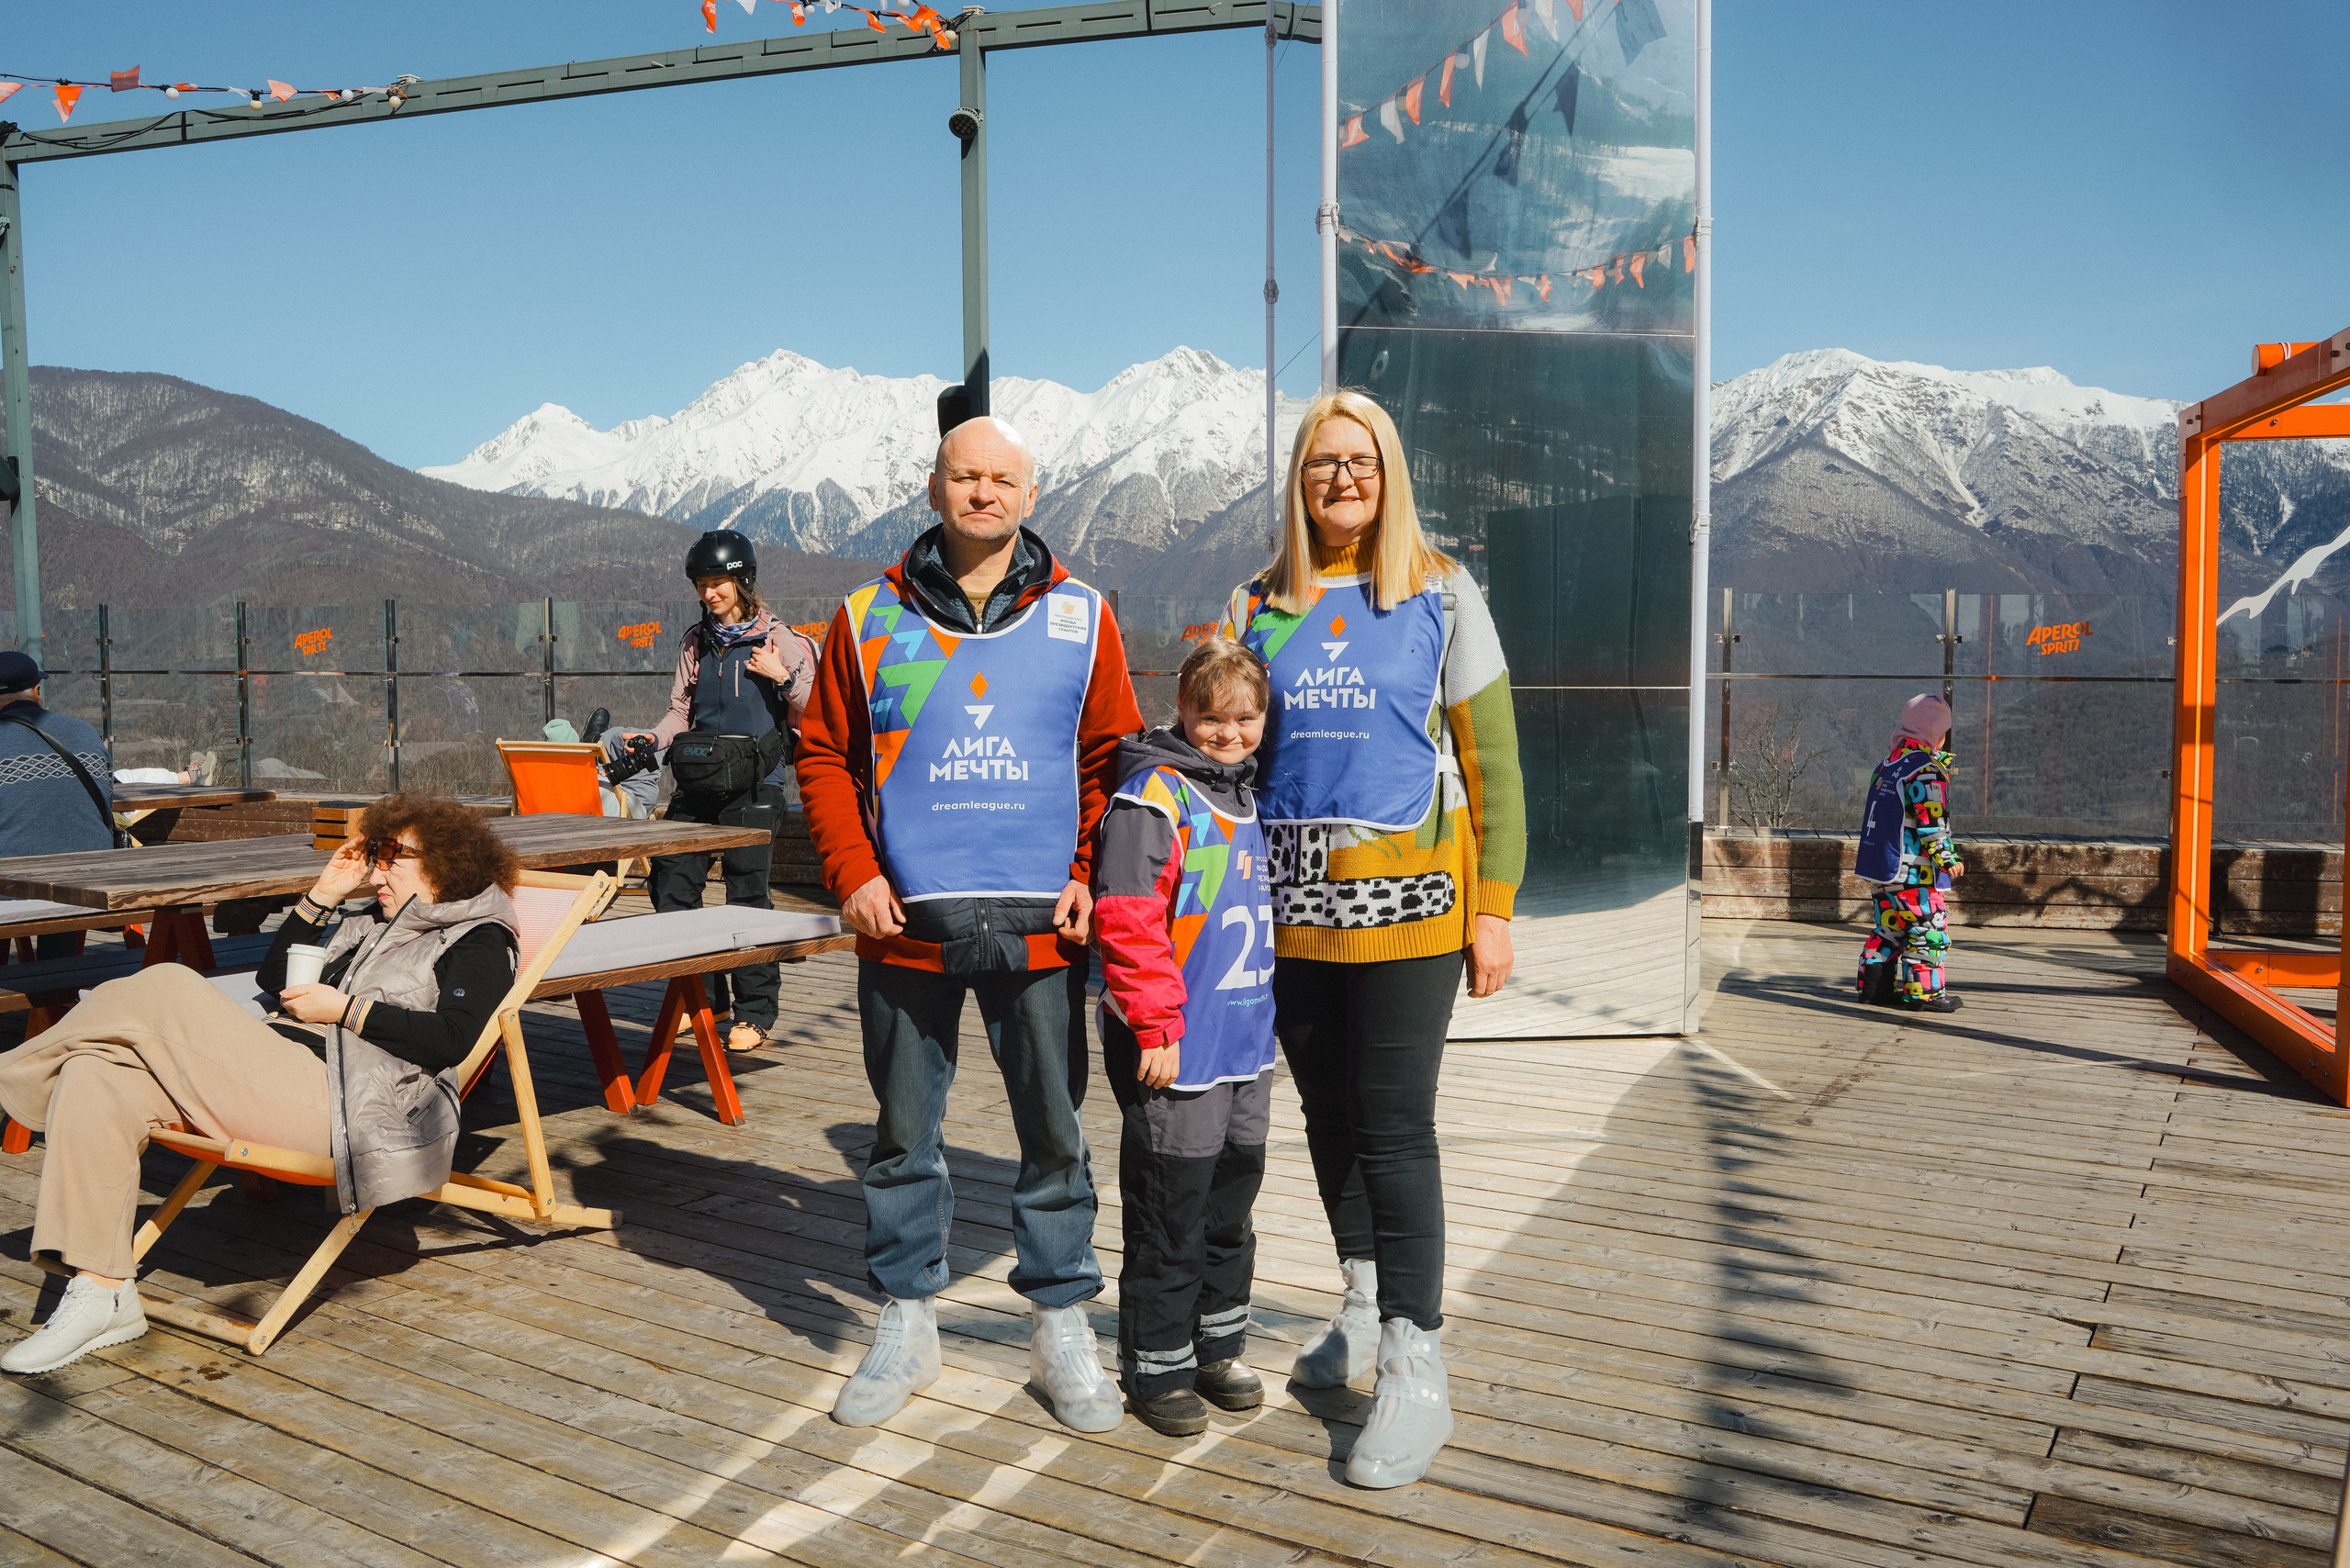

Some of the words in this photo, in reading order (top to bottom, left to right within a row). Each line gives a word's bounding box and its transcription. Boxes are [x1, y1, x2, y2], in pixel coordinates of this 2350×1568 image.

[294, 627, 333, 649] APEROL
[1181, 622, 1218, 643] APER
[2026, 621, 2093, 646] APEROL
[303, 641, 326, 655] SPRTZ
[2041, 638, 2080, 655] SPRITZ
[1294, 666, 1366, 687] ЛИГА
[1283, 688, 1377, 710] МЕЧТЫ
[1291, 730, 1370, 739] dreamleague.ru
[942, 736, 1017, 758] ЛИГА
[929, 759, 1028, 782] МЕЧТЫ
[932, 801, 1025, 812] dreamleague.ru
